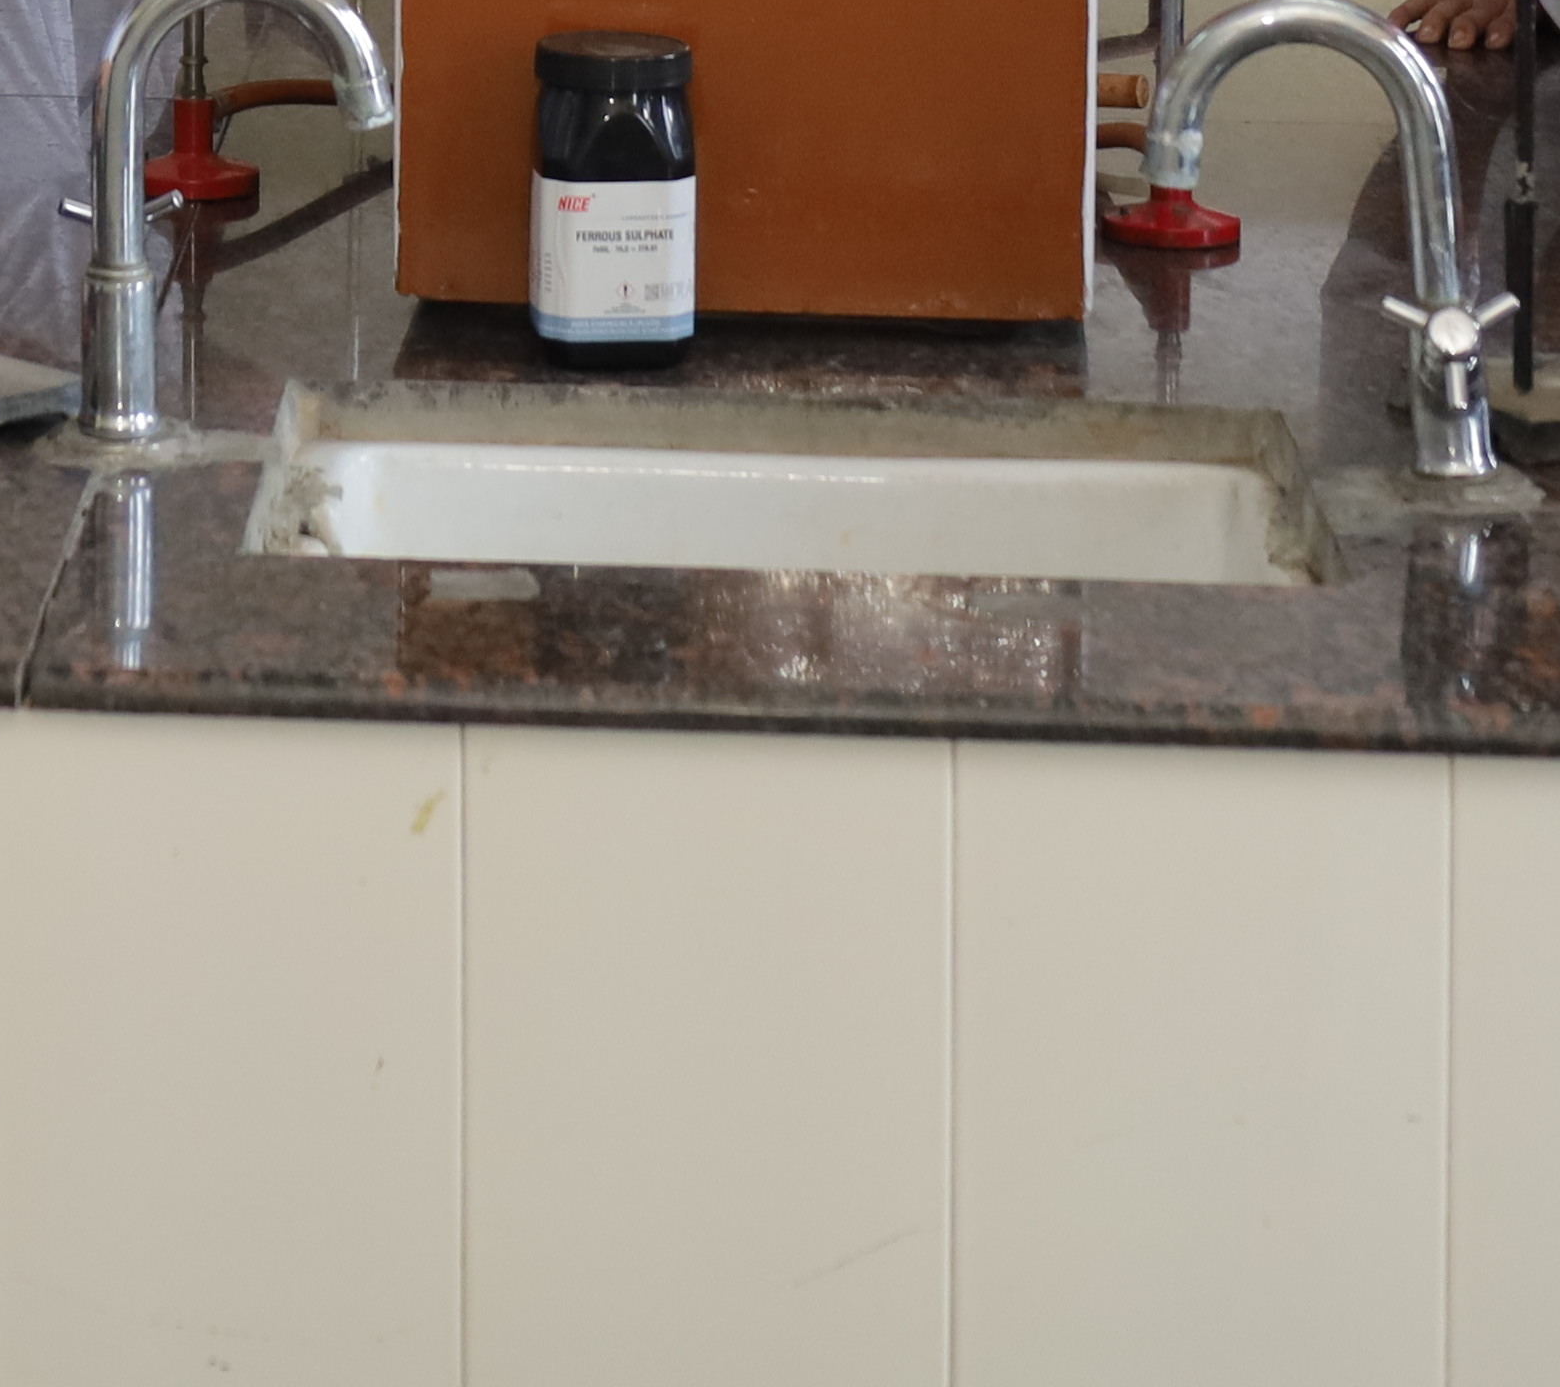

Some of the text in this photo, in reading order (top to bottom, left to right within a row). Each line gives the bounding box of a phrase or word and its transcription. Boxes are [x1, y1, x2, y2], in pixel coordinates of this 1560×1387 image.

[558, 195, 591, 212] NICE
[576, 229, 674, 242] FERROUS SULPHATE
